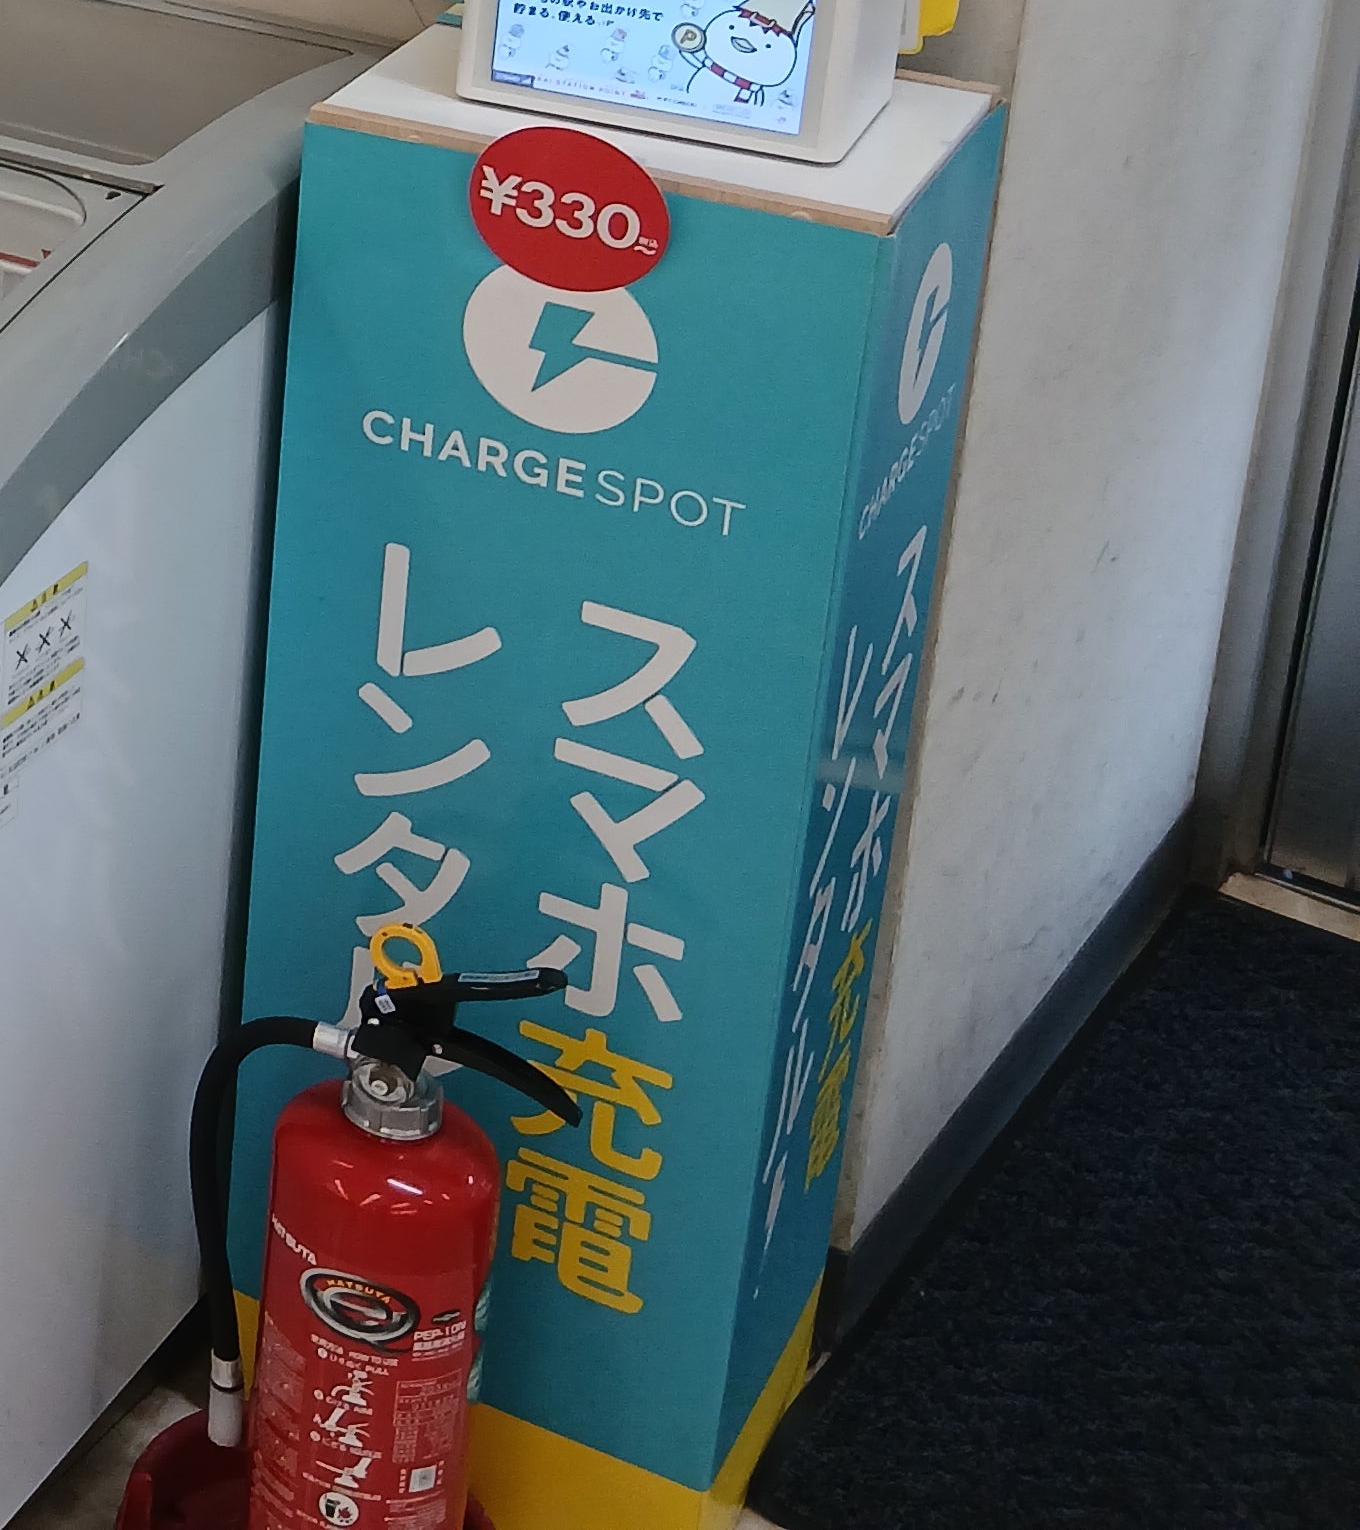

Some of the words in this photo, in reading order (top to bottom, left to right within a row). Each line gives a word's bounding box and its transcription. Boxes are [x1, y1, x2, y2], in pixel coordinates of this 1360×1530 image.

[361, 409, 747, 537] CHARGESPOT
[507, 600, 706, 1315] スマホ充電
